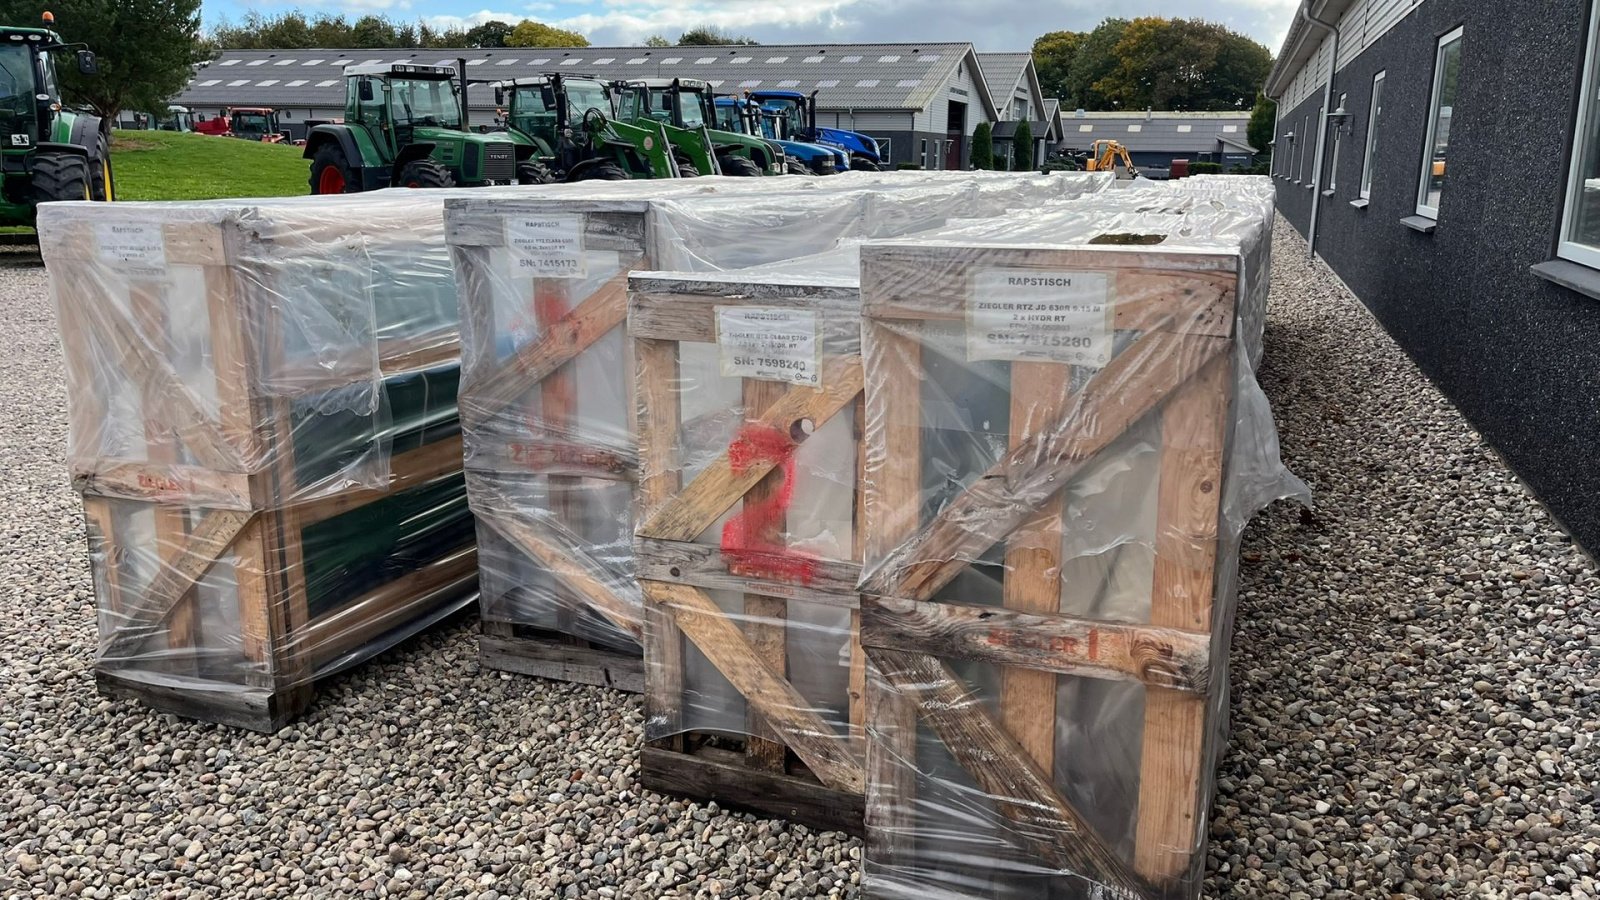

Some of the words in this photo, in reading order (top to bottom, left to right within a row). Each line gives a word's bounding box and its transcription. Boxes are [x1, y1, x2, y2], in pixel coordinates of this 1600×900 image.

[519, 259, 536, 267] SN:
[537, 259, 578, 267] 7415173
[1008, 277, 1072, 287] RAPSTISCH
[978, 302, 1014, 311] ZIEGLER
[1016, 303, 1034, 311] RTZ
[1013, 313, 1018, 321] 2
[1027, 314, 1052, 322] HYDR
[734, 357, 755, 367] SN:
[757, 358, 806, 371] 7598240
